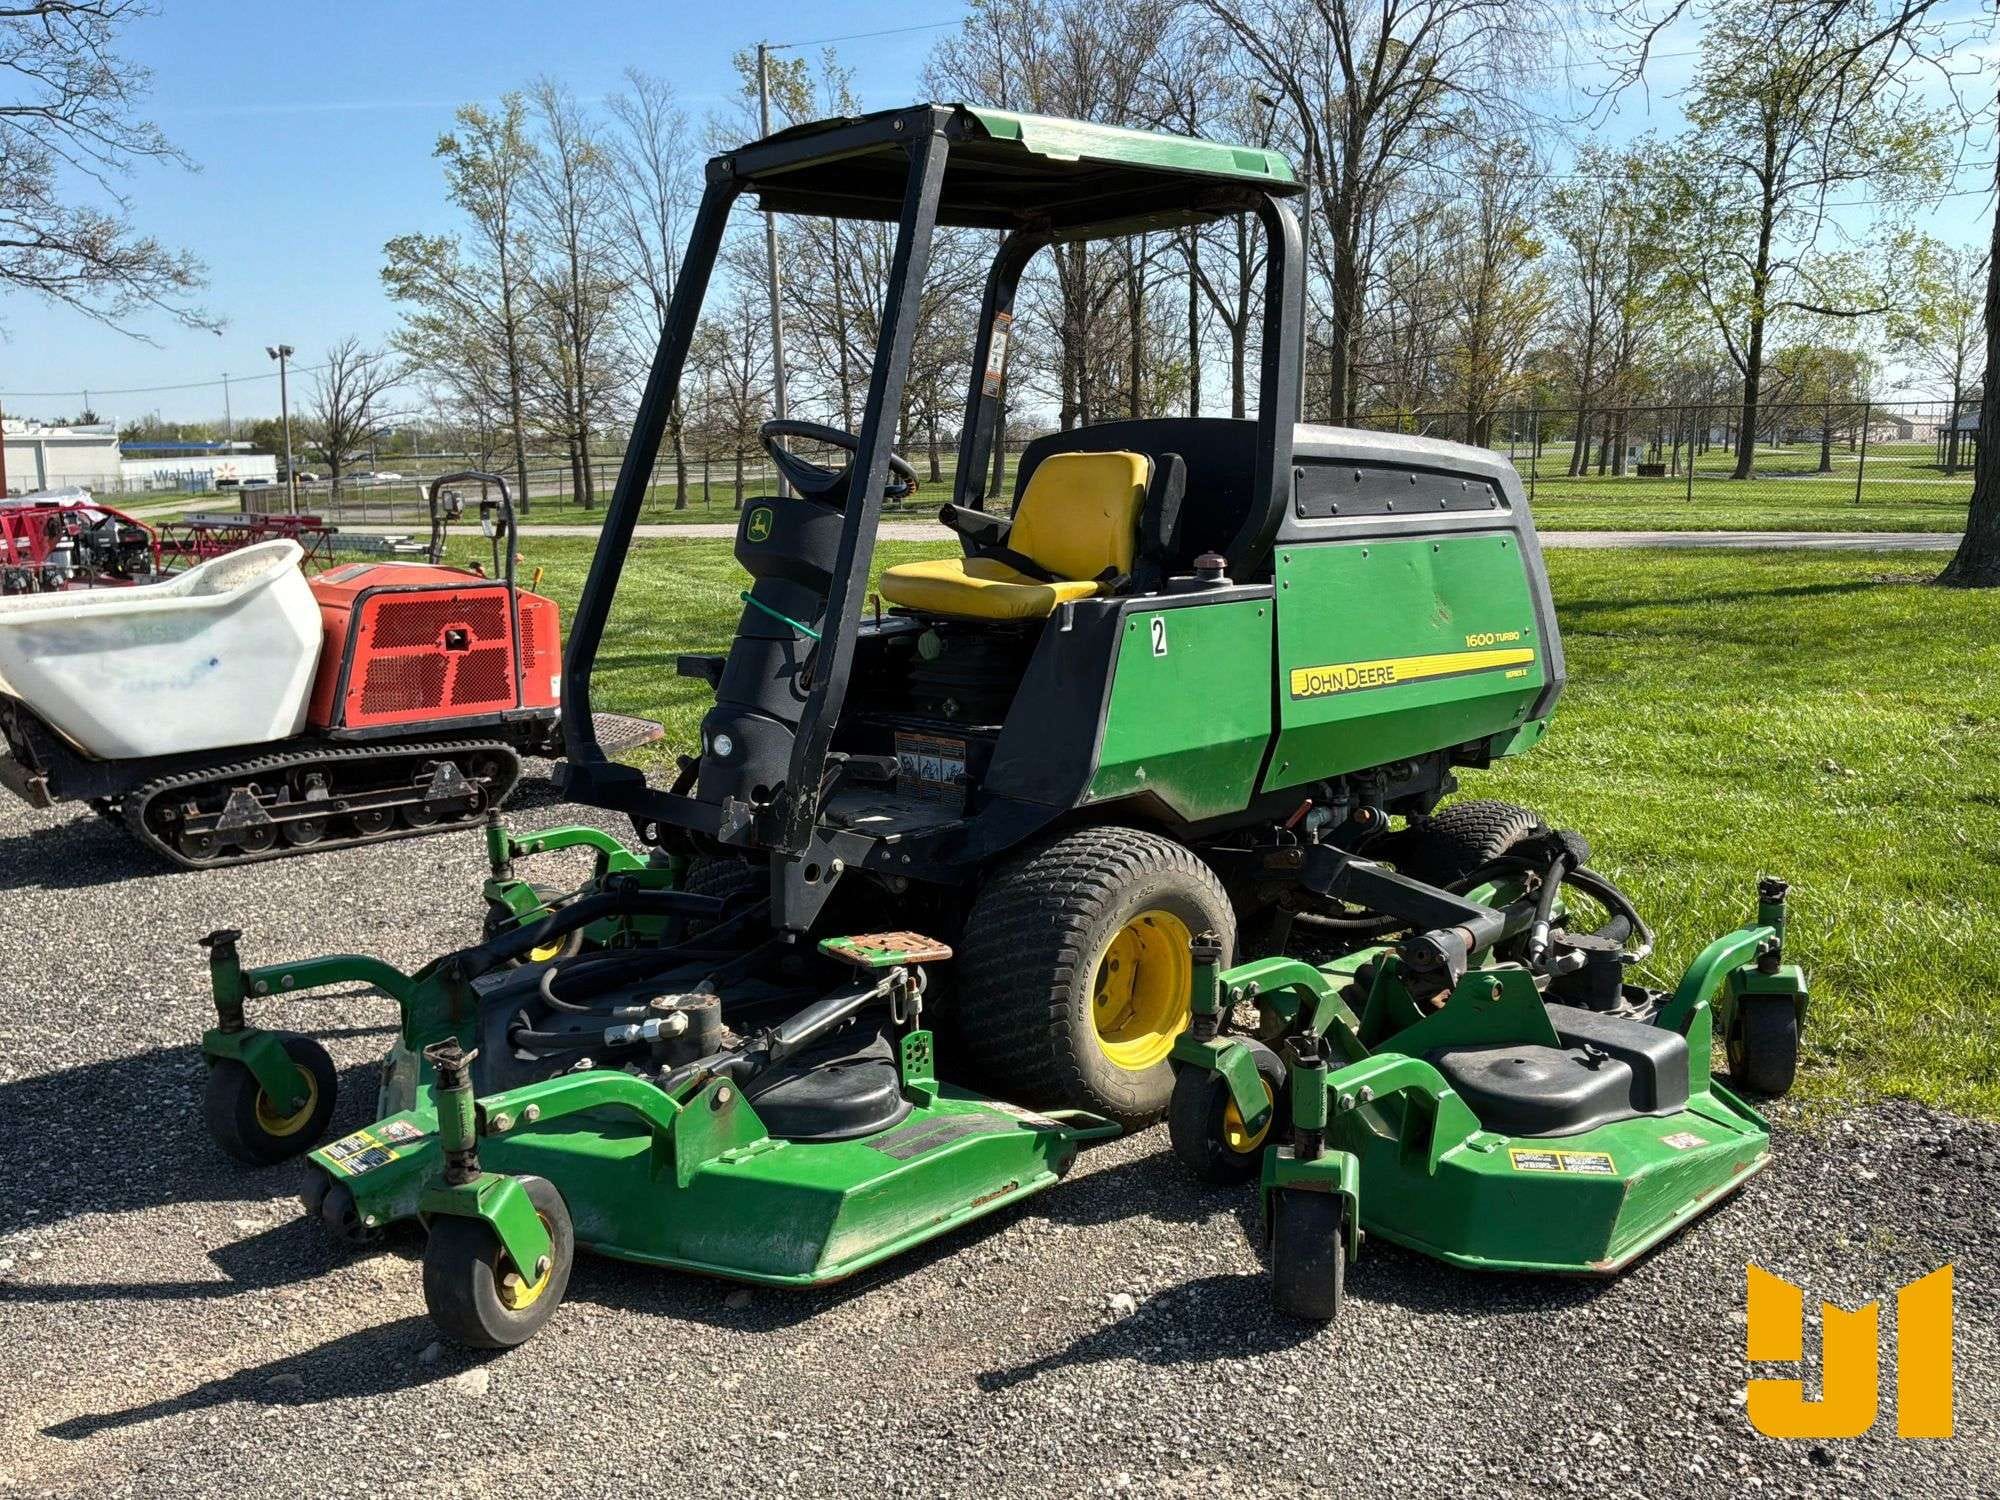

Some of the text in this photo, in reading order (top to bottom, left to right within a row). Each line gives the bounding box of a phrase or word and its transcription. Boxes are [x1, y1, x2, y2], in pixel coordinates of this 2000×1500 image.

[154, 467, 214, 482] Walmart
[1152, 619, 1165, 654] 2
[1465, 631, 1520, 648] 1600 TURBO
[1301, 666, 1395, 693] JOHN DEERE
